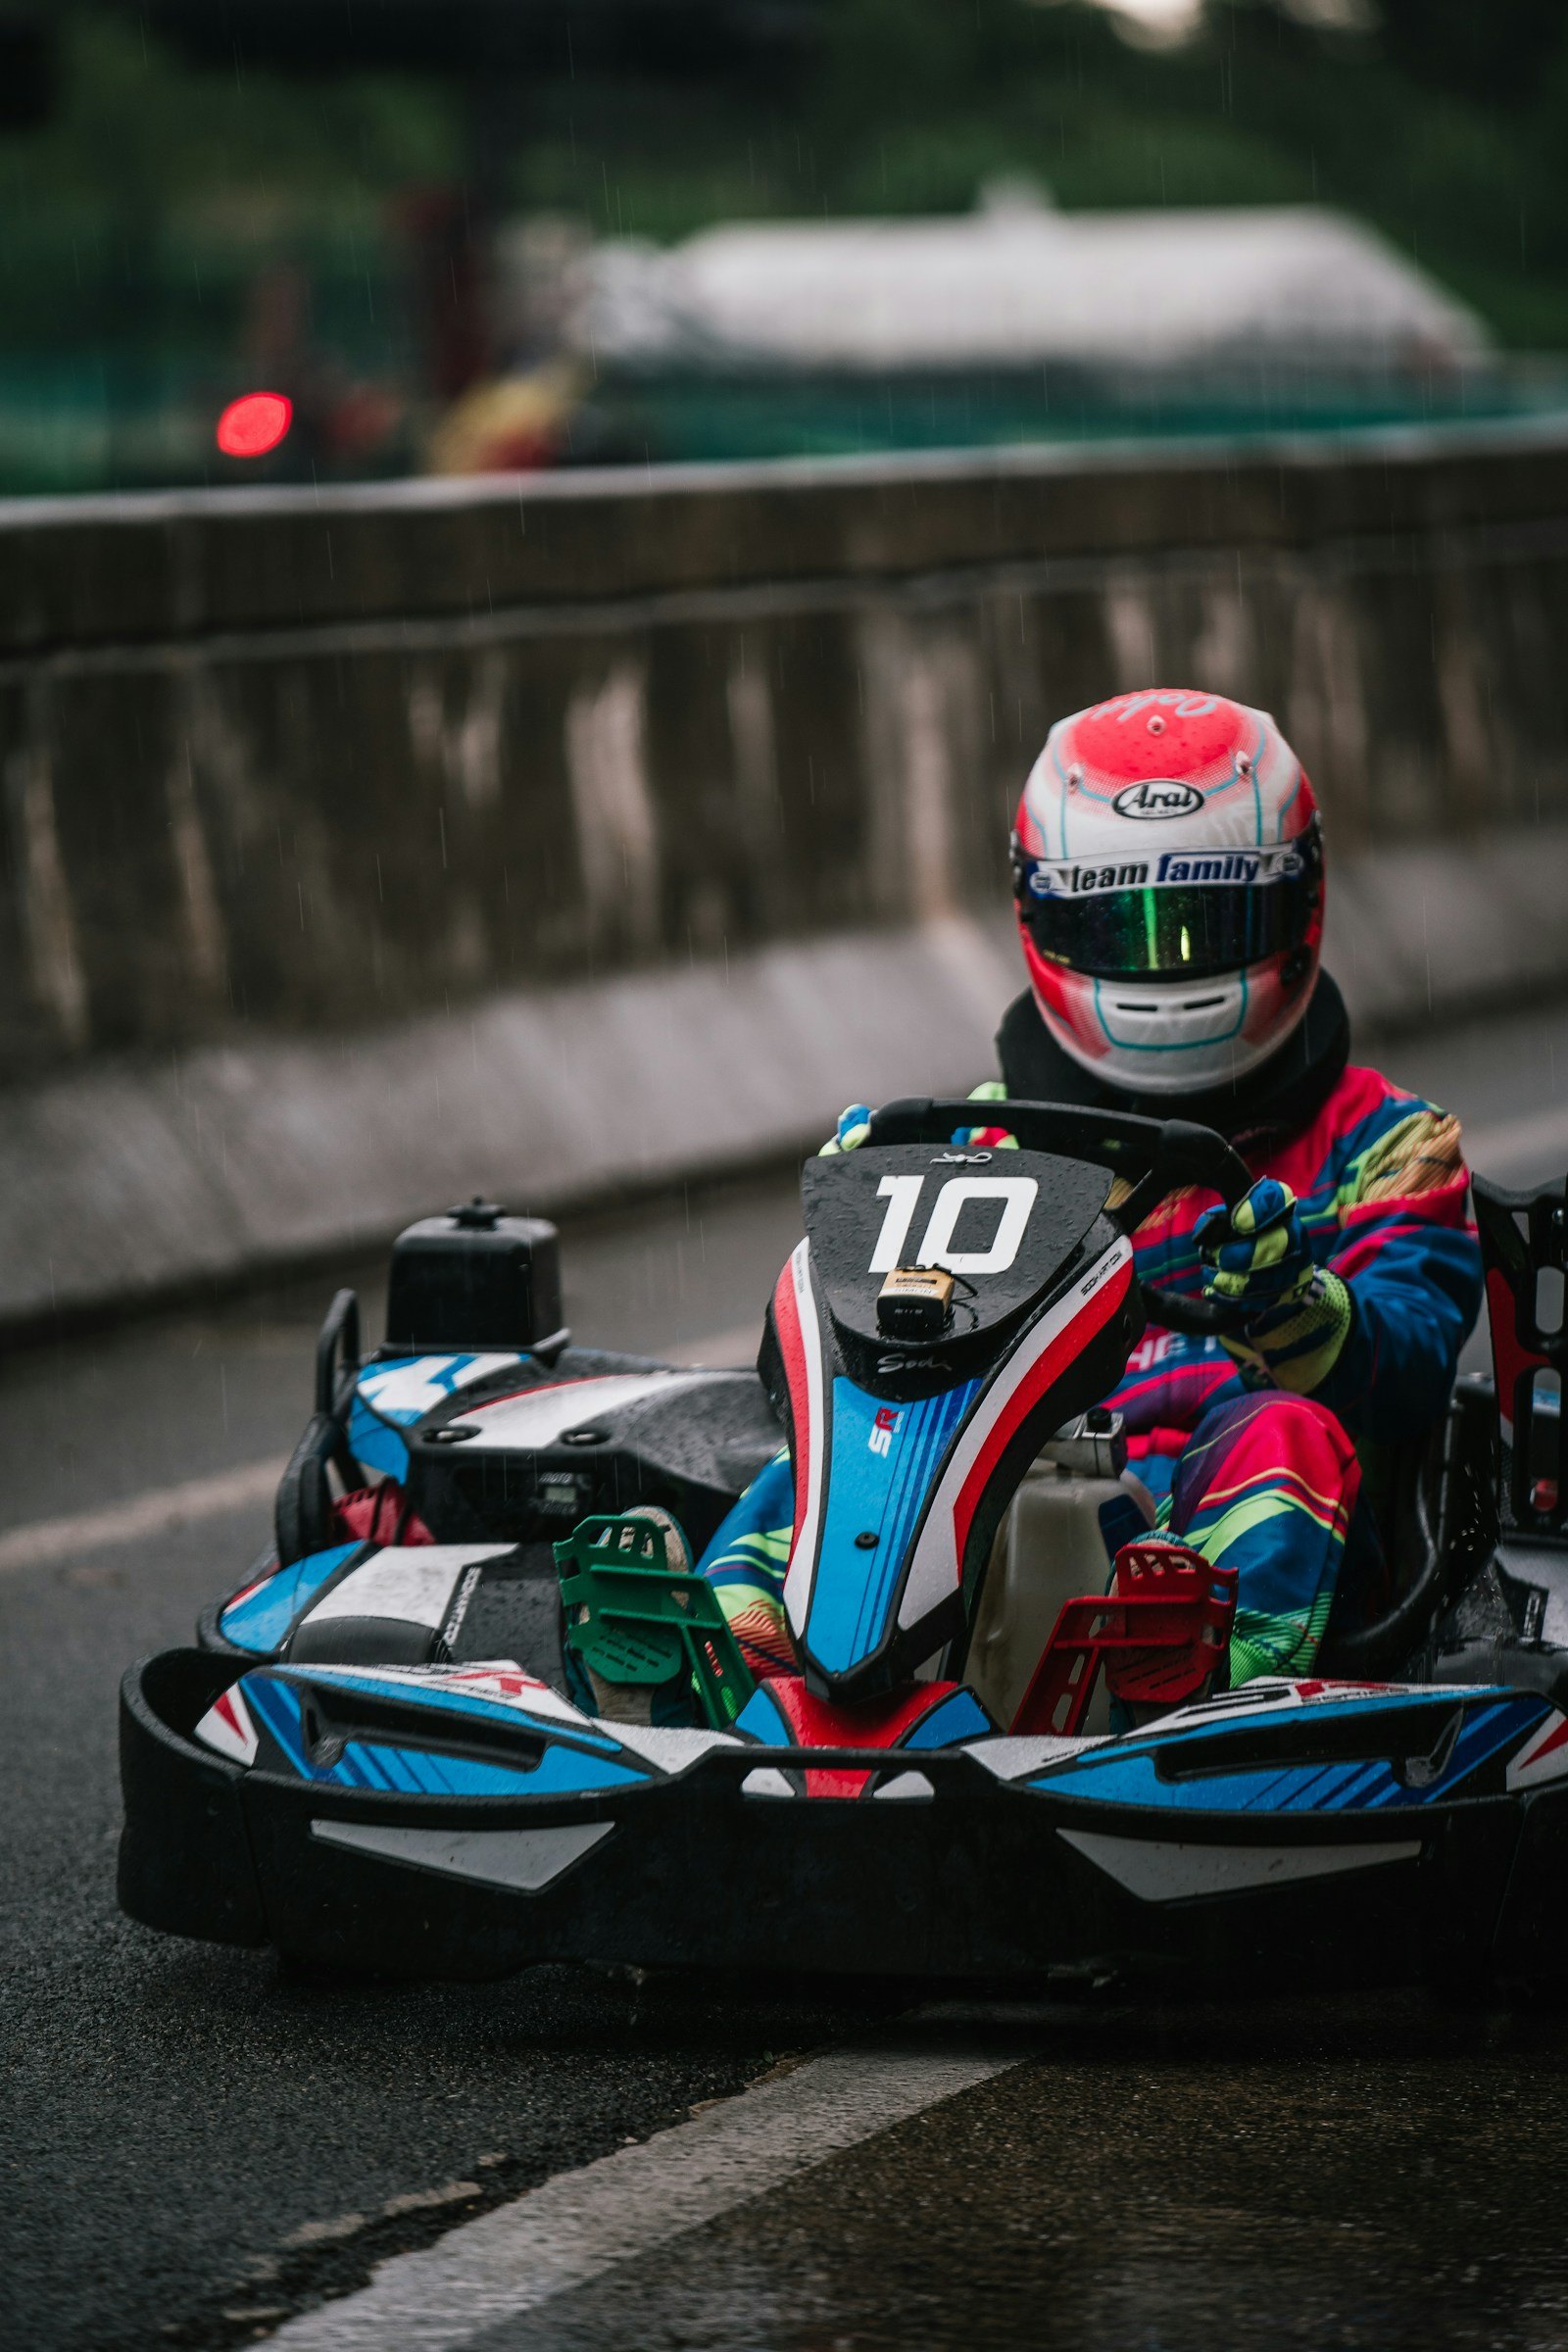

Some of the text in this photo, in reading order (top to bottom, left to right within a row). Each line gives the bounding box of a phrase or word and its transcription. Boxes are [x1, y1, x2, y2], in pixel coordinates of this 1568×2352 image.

[1116, 784, 1193, 809] Arai
[1071, 863, 1149, 893] team
[1155, 851, 1261, 882] family
[868, 1175, 1039, 1275] 10
[867, 1405, 899, 1458] SR
